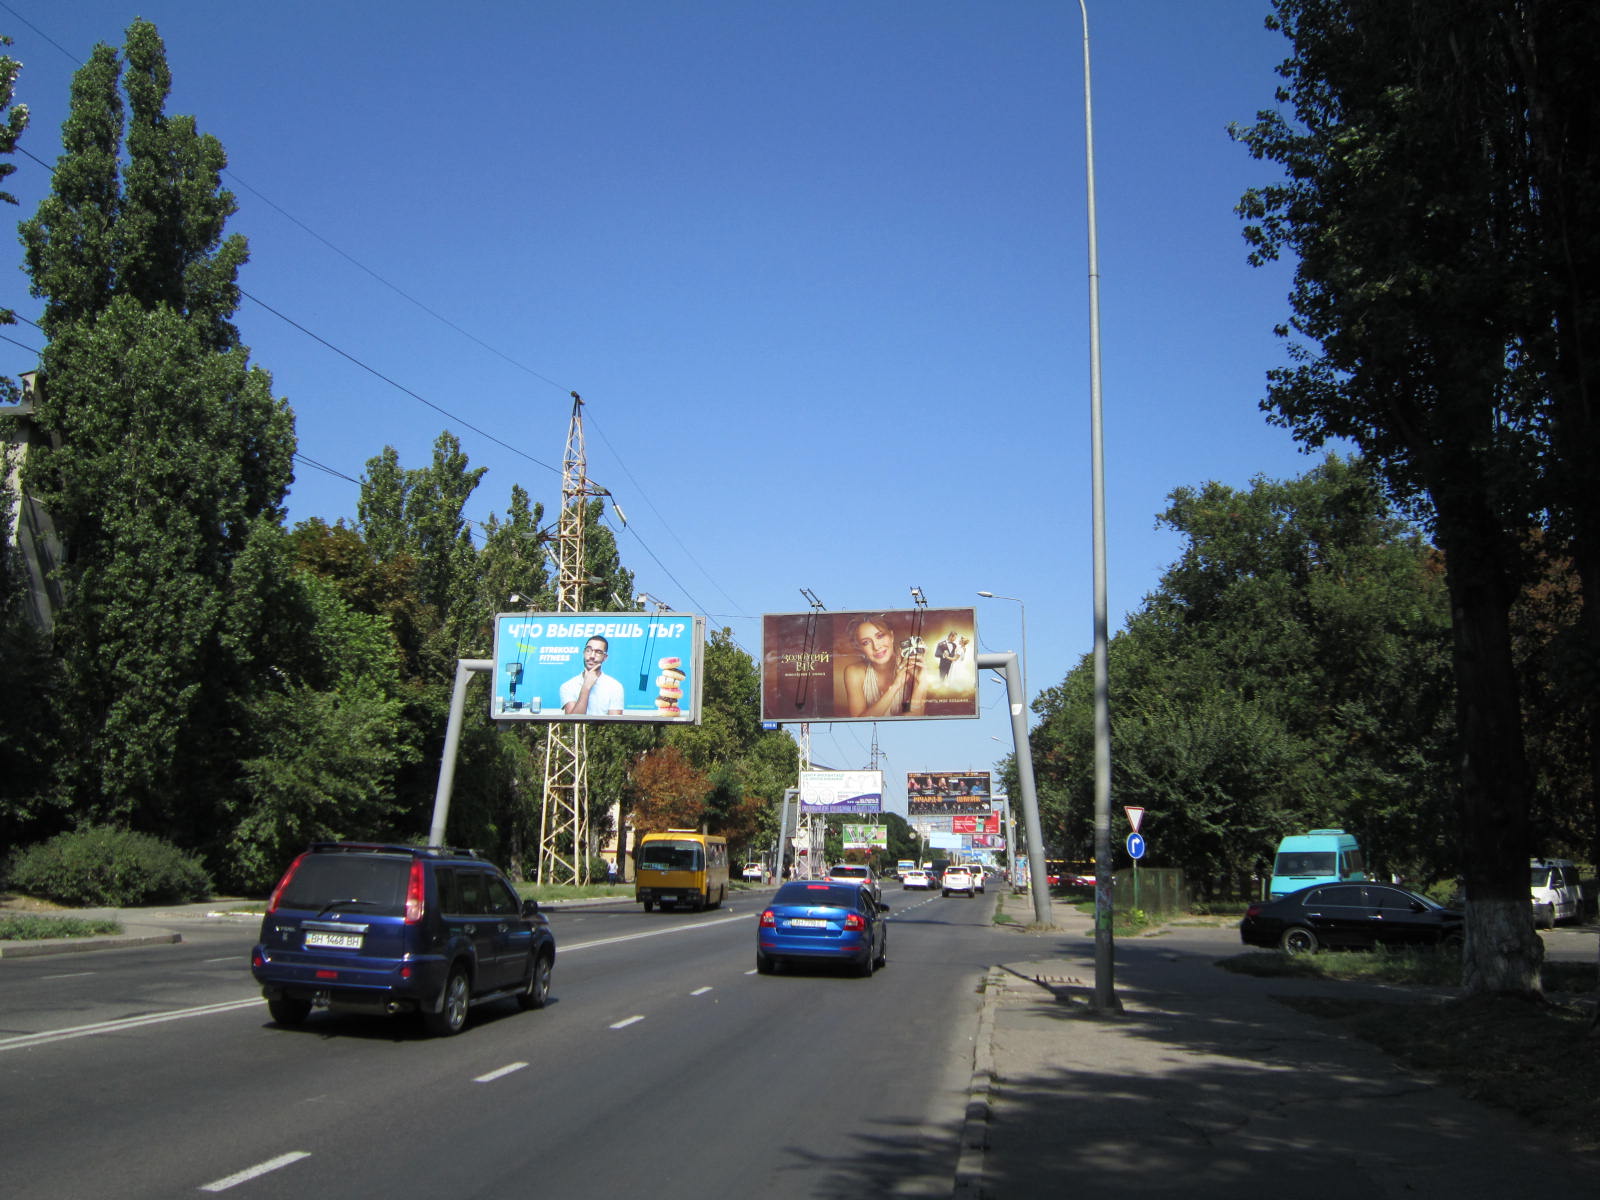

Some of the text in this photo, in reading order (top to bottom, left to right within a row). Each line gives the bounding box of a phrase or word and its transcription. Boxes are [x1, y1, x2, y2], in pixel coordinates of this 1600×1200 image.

[509, 623, 685, 638] ЧТО ВЫБЕРЕШЬ ТЫ?
[540, 646, 579, 654] STREKOZA
[311, 934, 323, 943] BH
